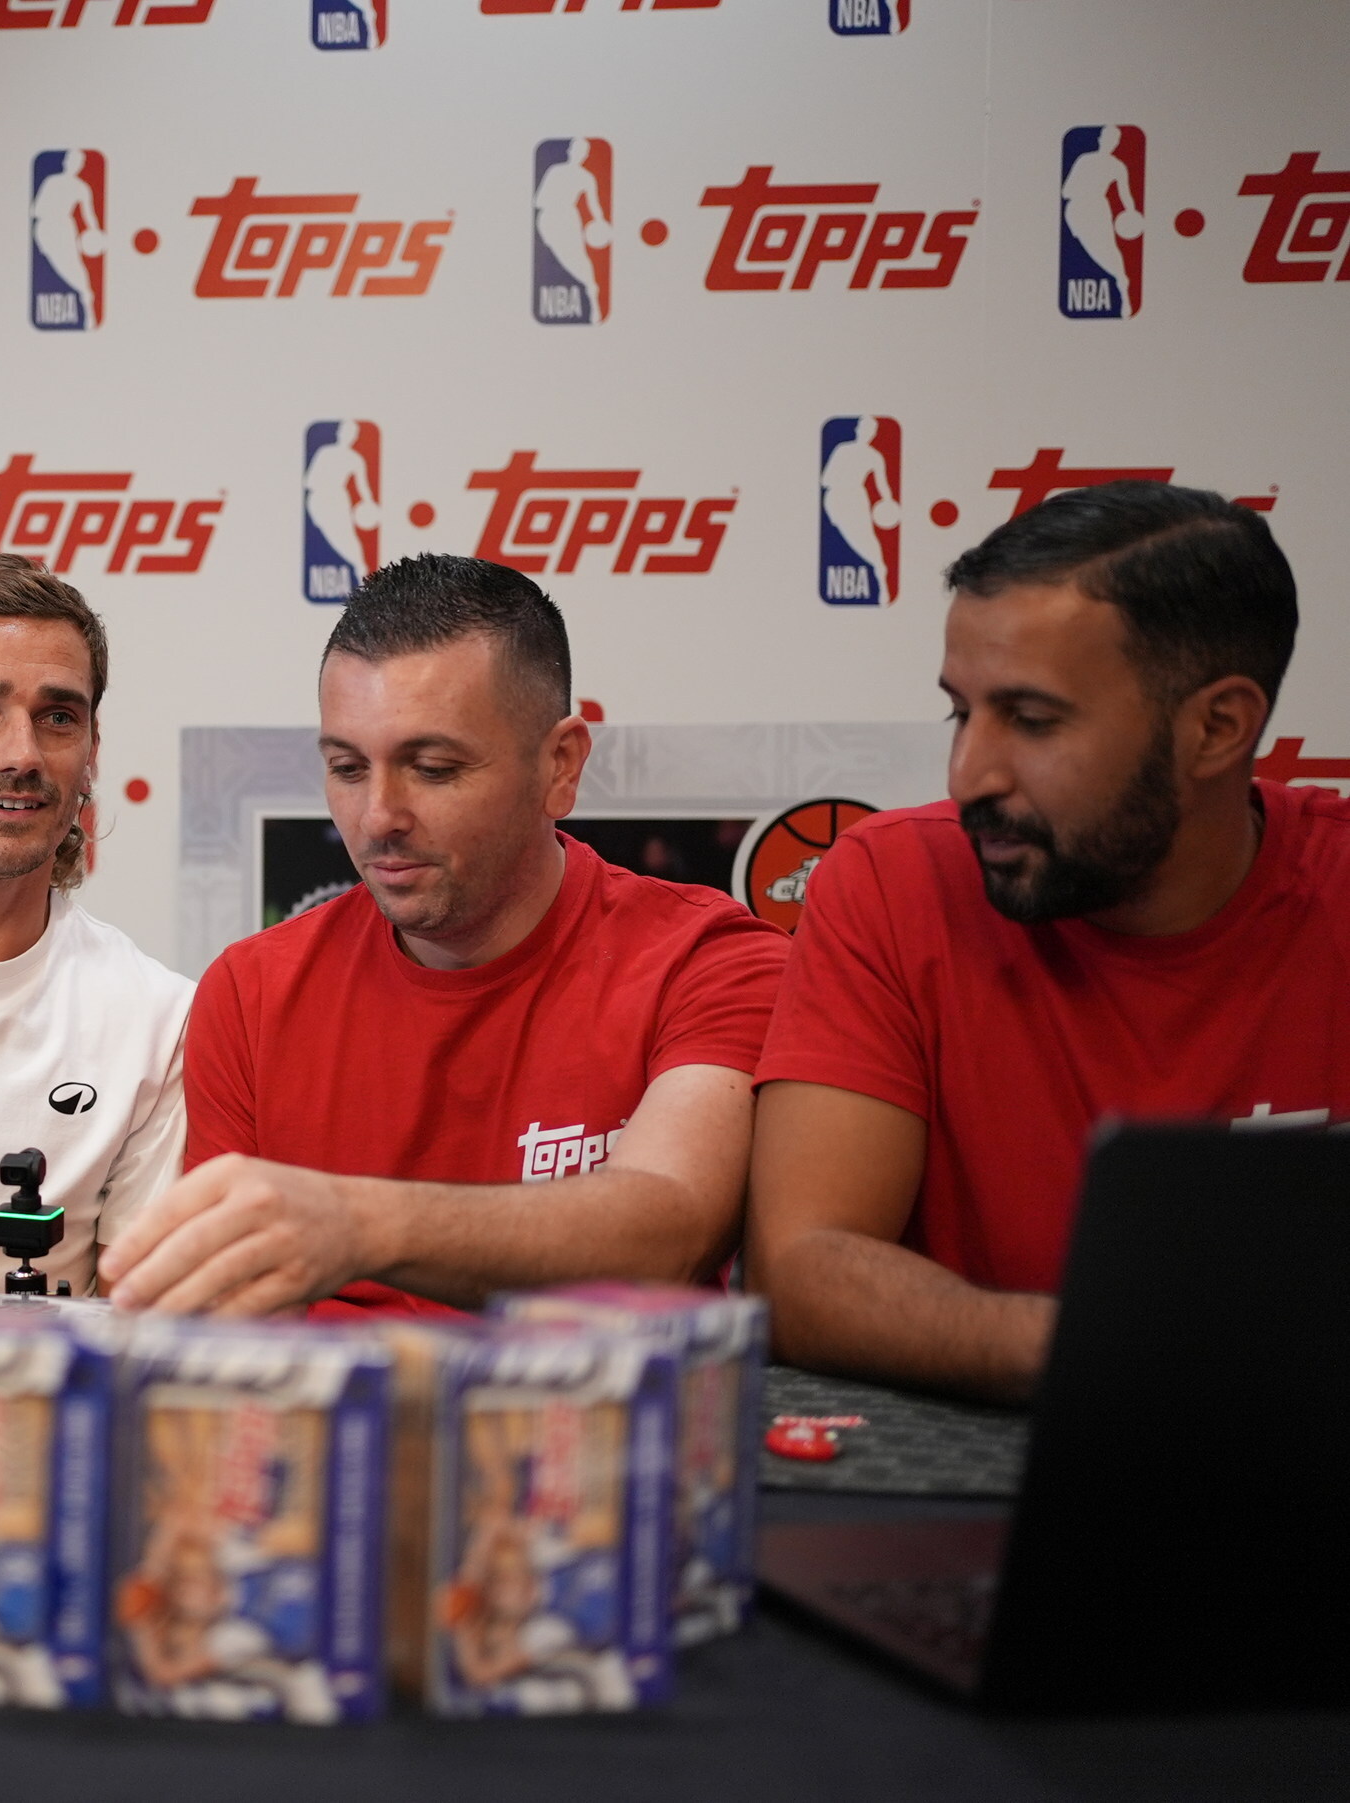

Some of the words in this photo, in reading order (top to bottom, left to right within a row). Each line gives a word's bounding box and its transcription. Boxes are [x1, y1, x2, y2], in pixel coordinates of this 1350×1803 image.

[837, 0, 881, 28] NBA
[539, 285, 583, 318] NBA
[1067, 278, 1111, 312] NBA
[826, 564, 871, 600] NBA
